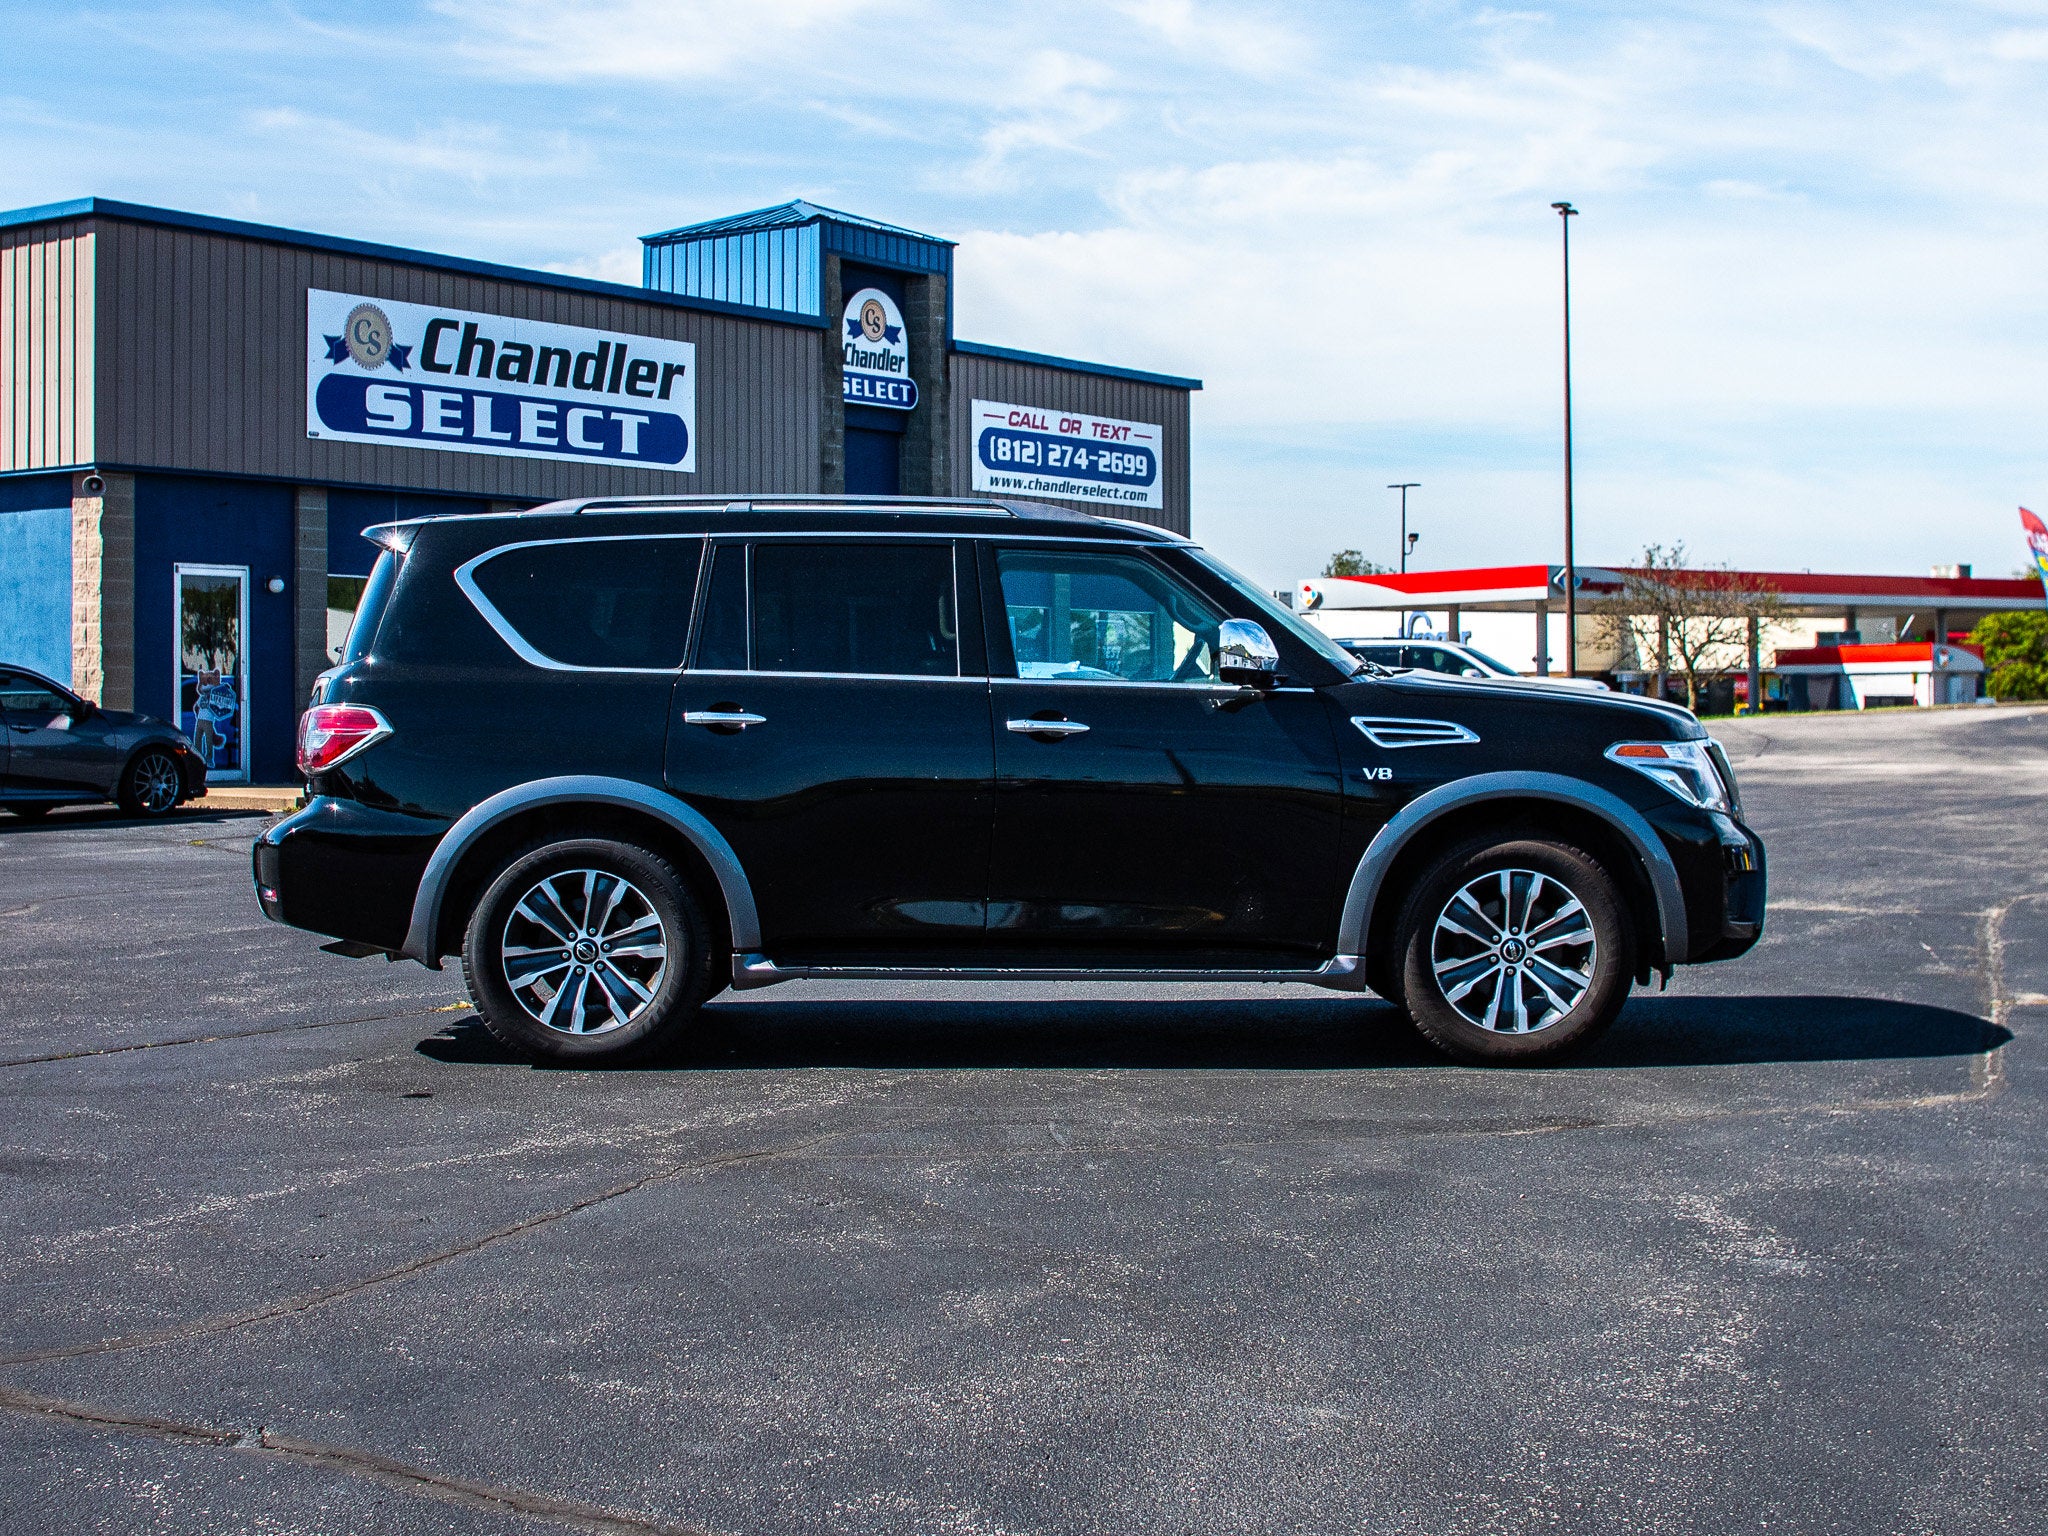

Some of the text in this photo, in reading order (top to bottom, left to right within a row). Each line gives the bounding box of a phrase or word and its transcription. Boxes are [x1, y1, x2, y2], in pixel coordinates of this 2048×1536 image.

[420, 317, 685, 401] Chandler
[843, 342, 905, 373] Chandler
[365, 383, 650, 454] SELECT
[1008, 411, 1131, 441] CALL OR TEXT
[990, 435, 1148, 477] (812) 274-2699
[989, 476, 1148, 502] www.chandlerselect.com
[1362, 767, 1393, 780] V8
